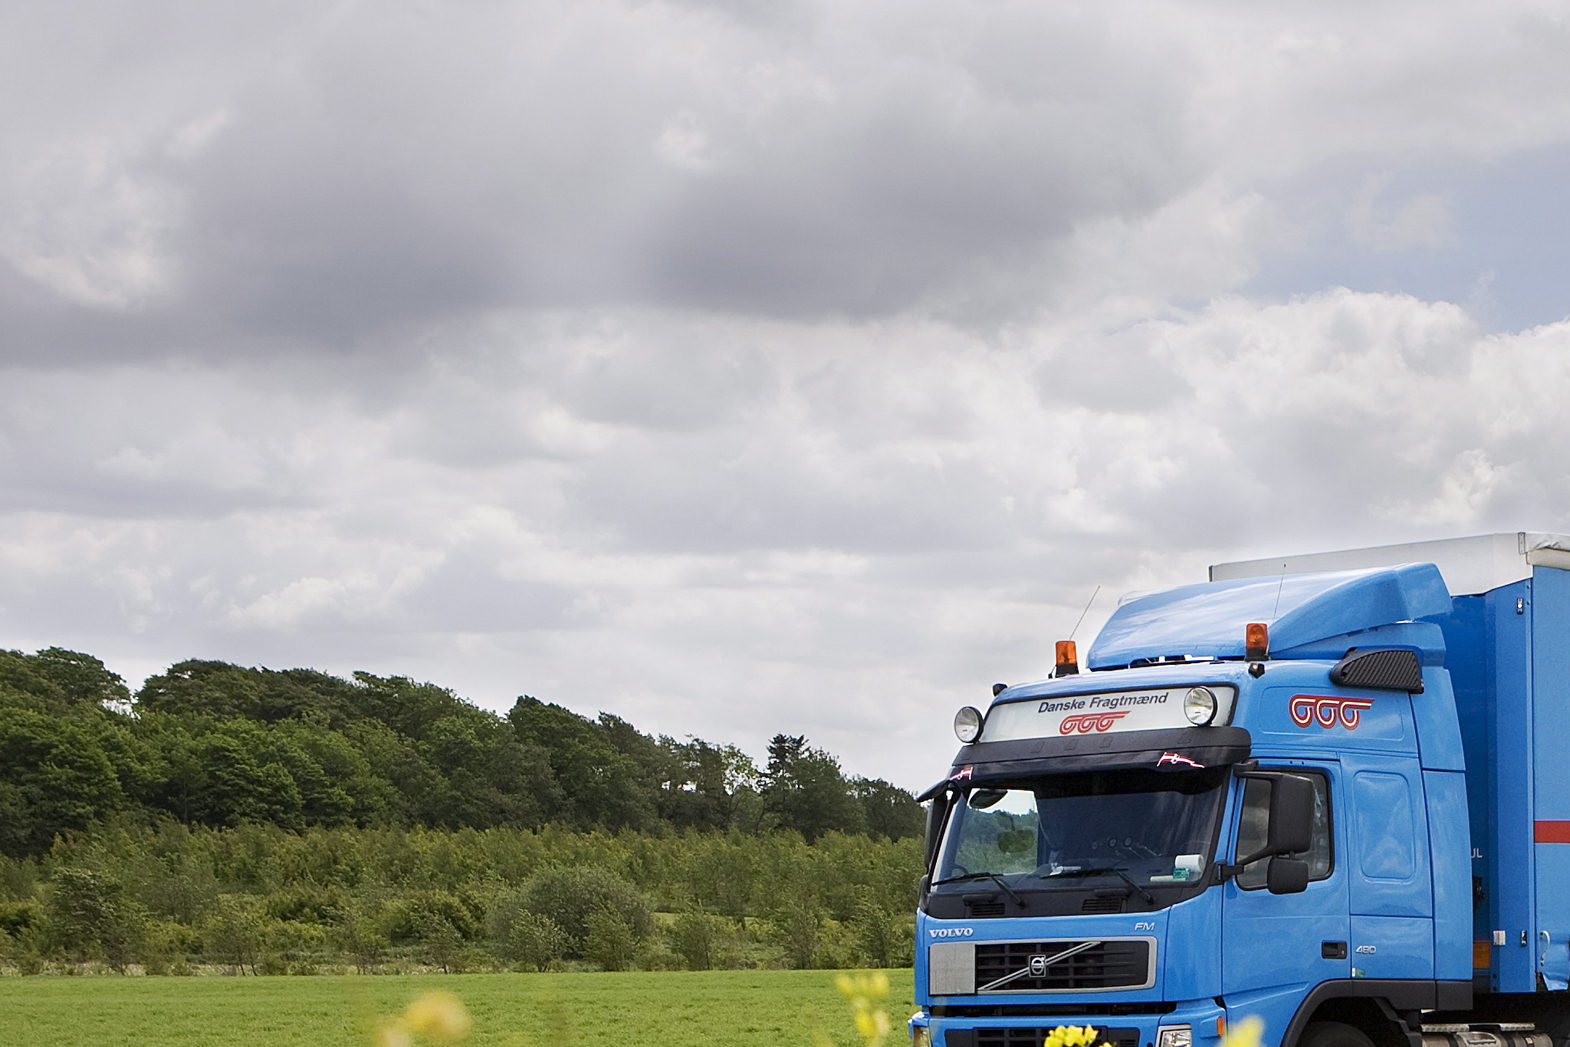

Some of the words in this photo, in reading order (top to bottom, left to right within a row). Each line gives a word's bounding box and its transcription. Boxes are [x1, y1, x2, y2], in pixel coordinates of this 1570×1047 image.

[1038, 699, 1085, 713] Danske
[1089, 692, 1169, 709] Fragtmænd
[1134, 922, 1155, 931] FM
[929, 927, 974, 938] VOLVO
[1355, 945, 1377, 954] 480
